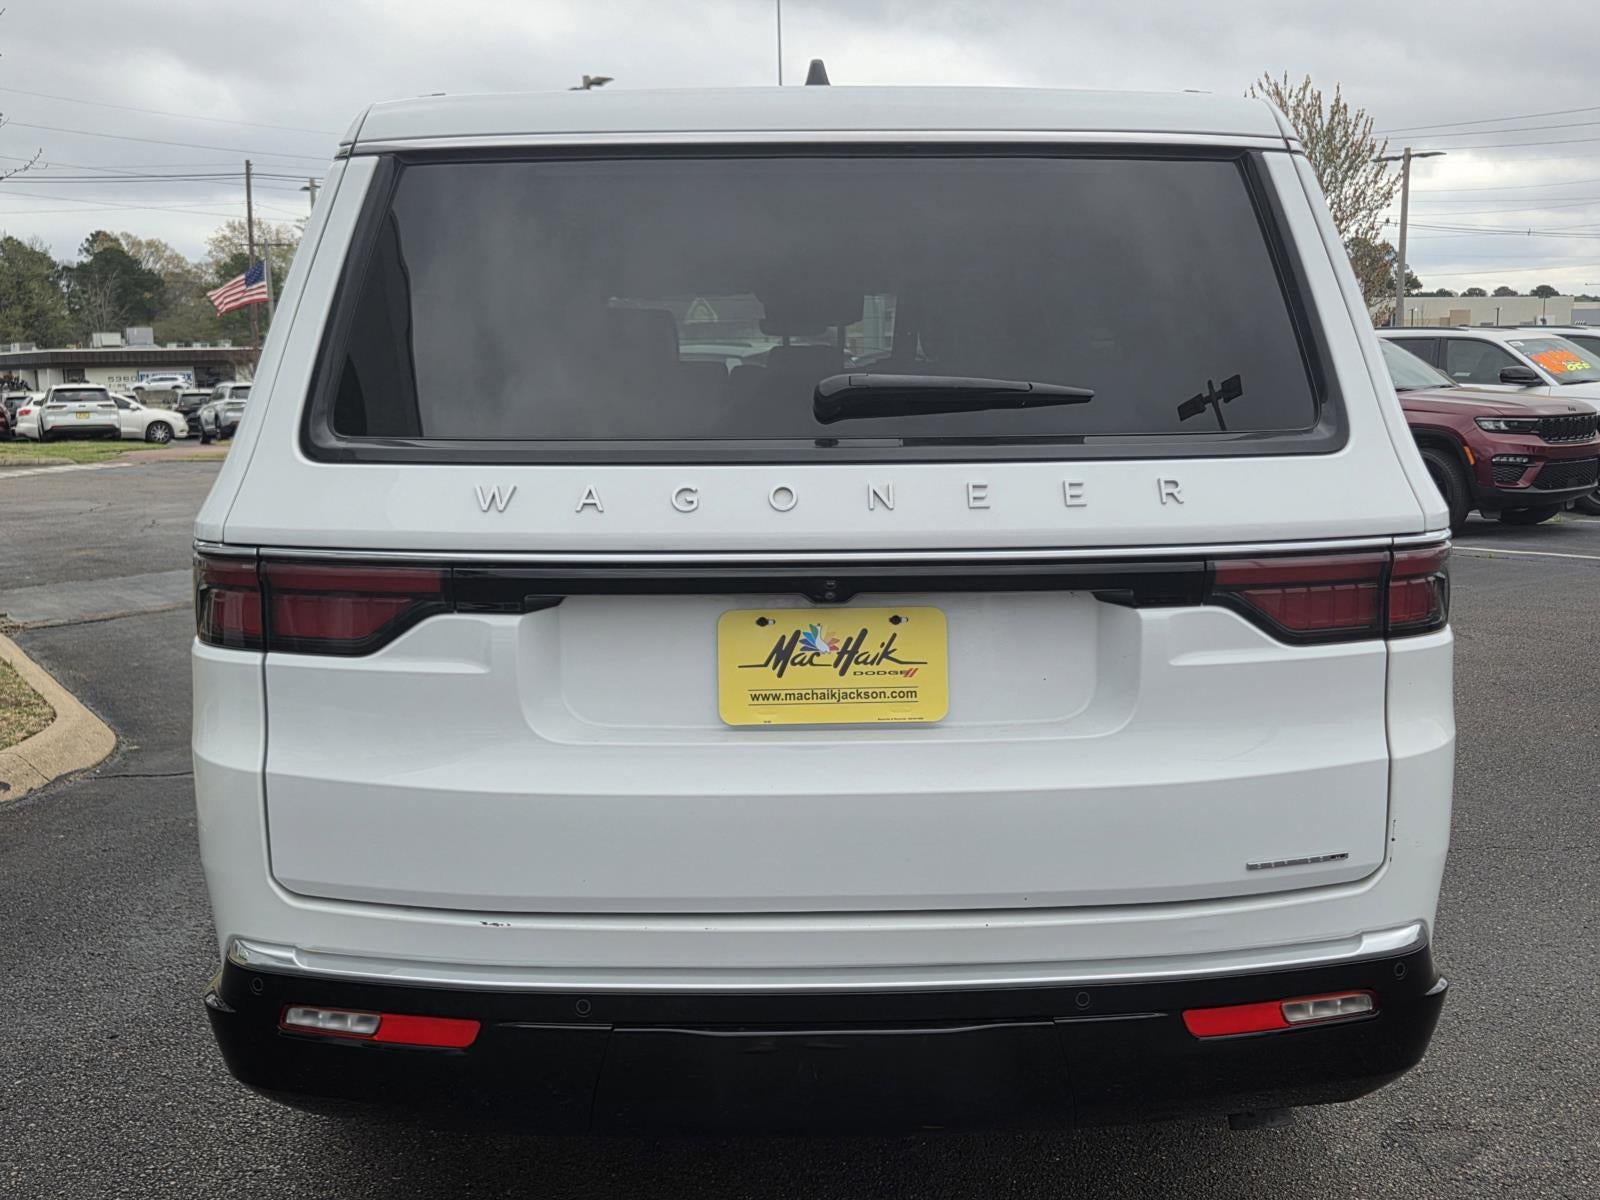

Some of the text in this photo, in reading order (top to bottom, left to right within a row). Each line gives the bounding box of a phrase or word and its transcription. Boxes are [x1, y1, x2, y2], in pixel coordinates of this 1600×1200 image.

[475, 477, 1184, 513] WAGONEER
[738, 628, 928, 678] Mac Haik
[750, 688, 918, 702] www.machaikjackson.com
